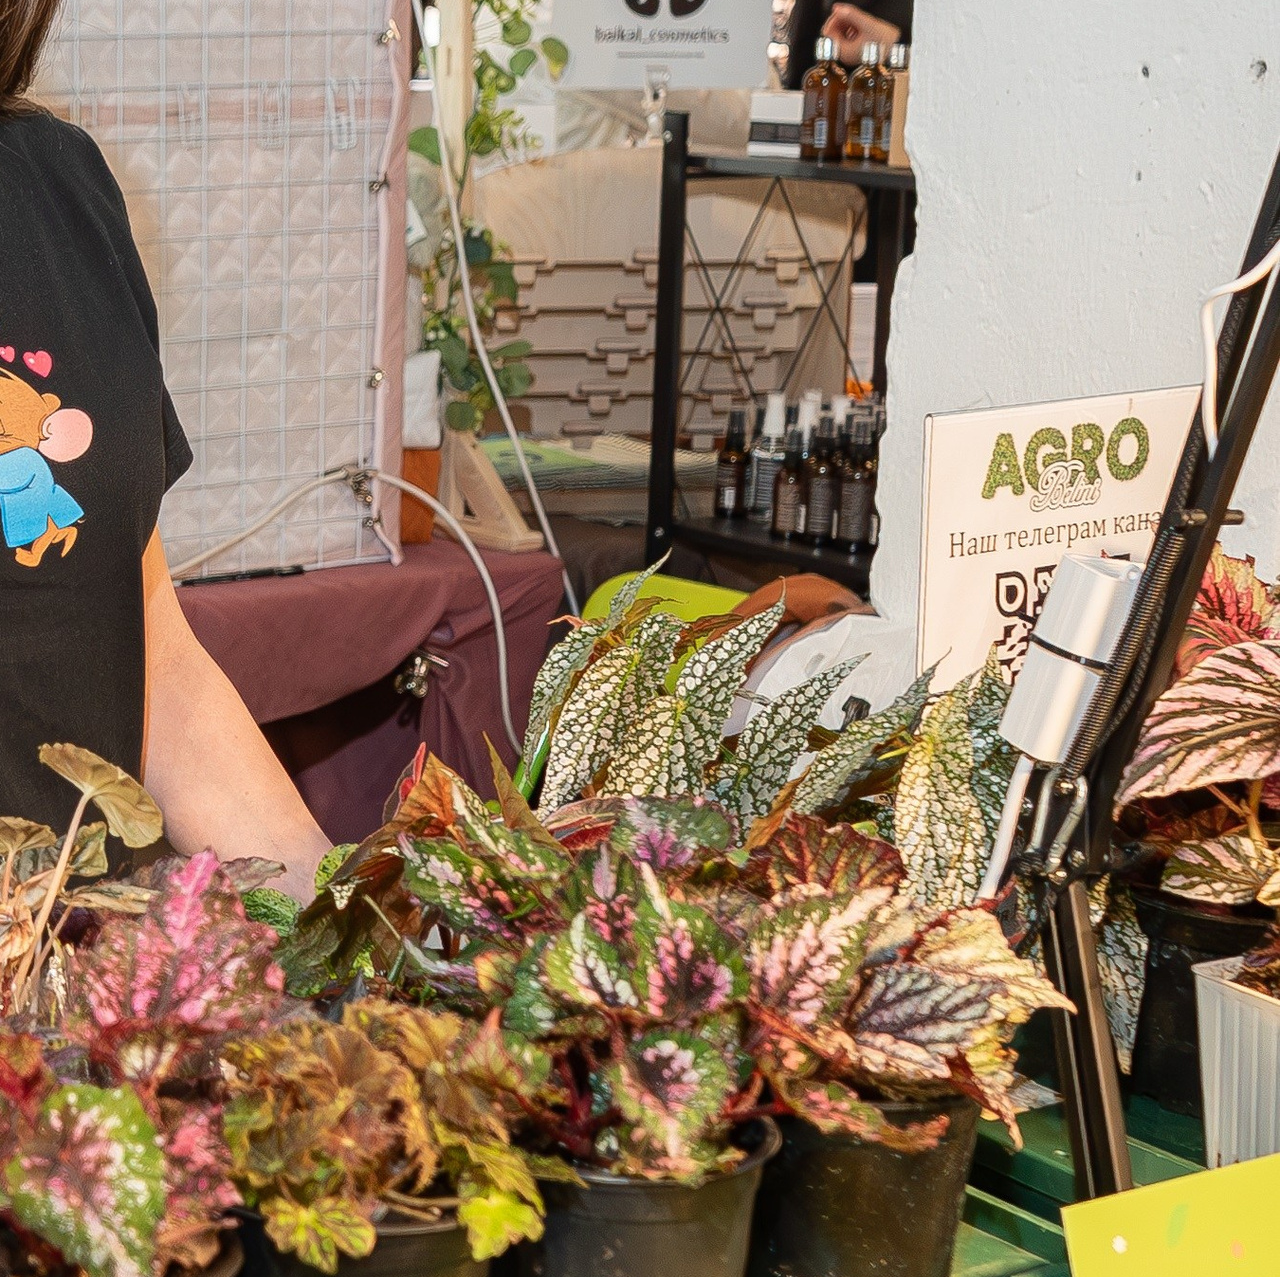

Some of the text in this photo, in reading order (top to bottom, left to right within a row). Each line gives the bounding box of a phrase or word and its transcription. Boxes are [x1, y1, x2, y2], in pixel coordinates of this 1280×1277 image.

[981, 417, 1150, 499] AGRO
[948, 529, 998, 558] Наш
[1004, 519, 1108, 550] телеграм
